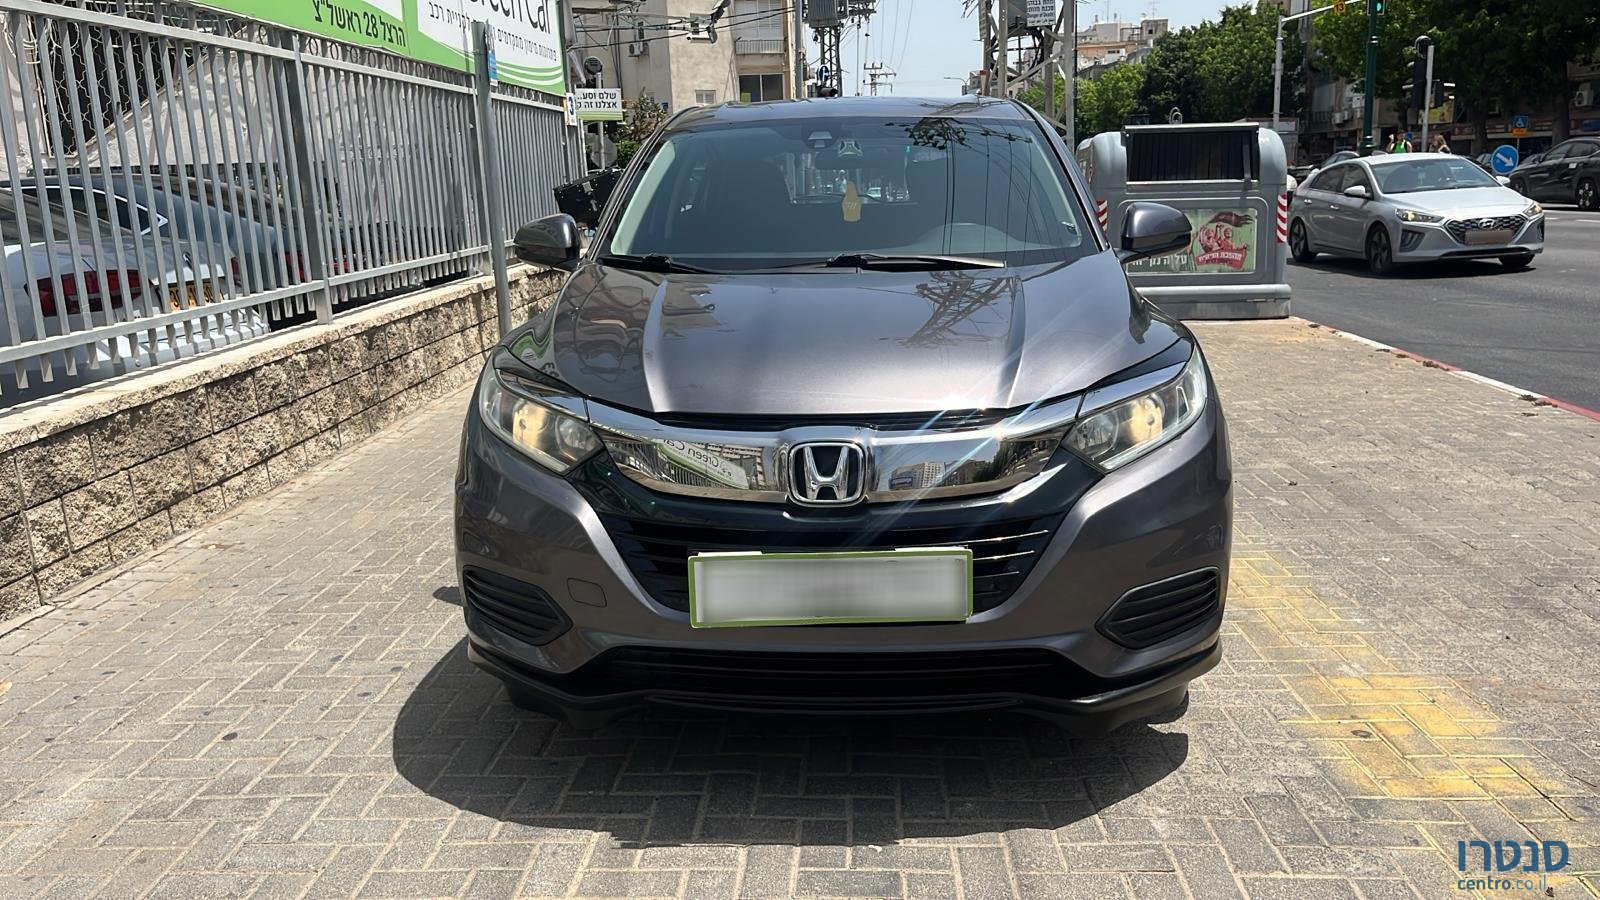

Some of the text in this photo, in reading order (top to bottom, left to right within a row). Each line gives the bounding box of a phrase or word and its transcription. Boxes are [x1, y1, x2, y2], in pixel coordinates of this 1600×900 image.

[428, 2, 445, 22] רכב
[363, 11, 379, 38] 28
[379, 15, 406, 47] הרצל
[599, 91, 617, 100] שלם
[584, 101, 593, 109] זה
[595, 100, 617, 109] אצלנו
